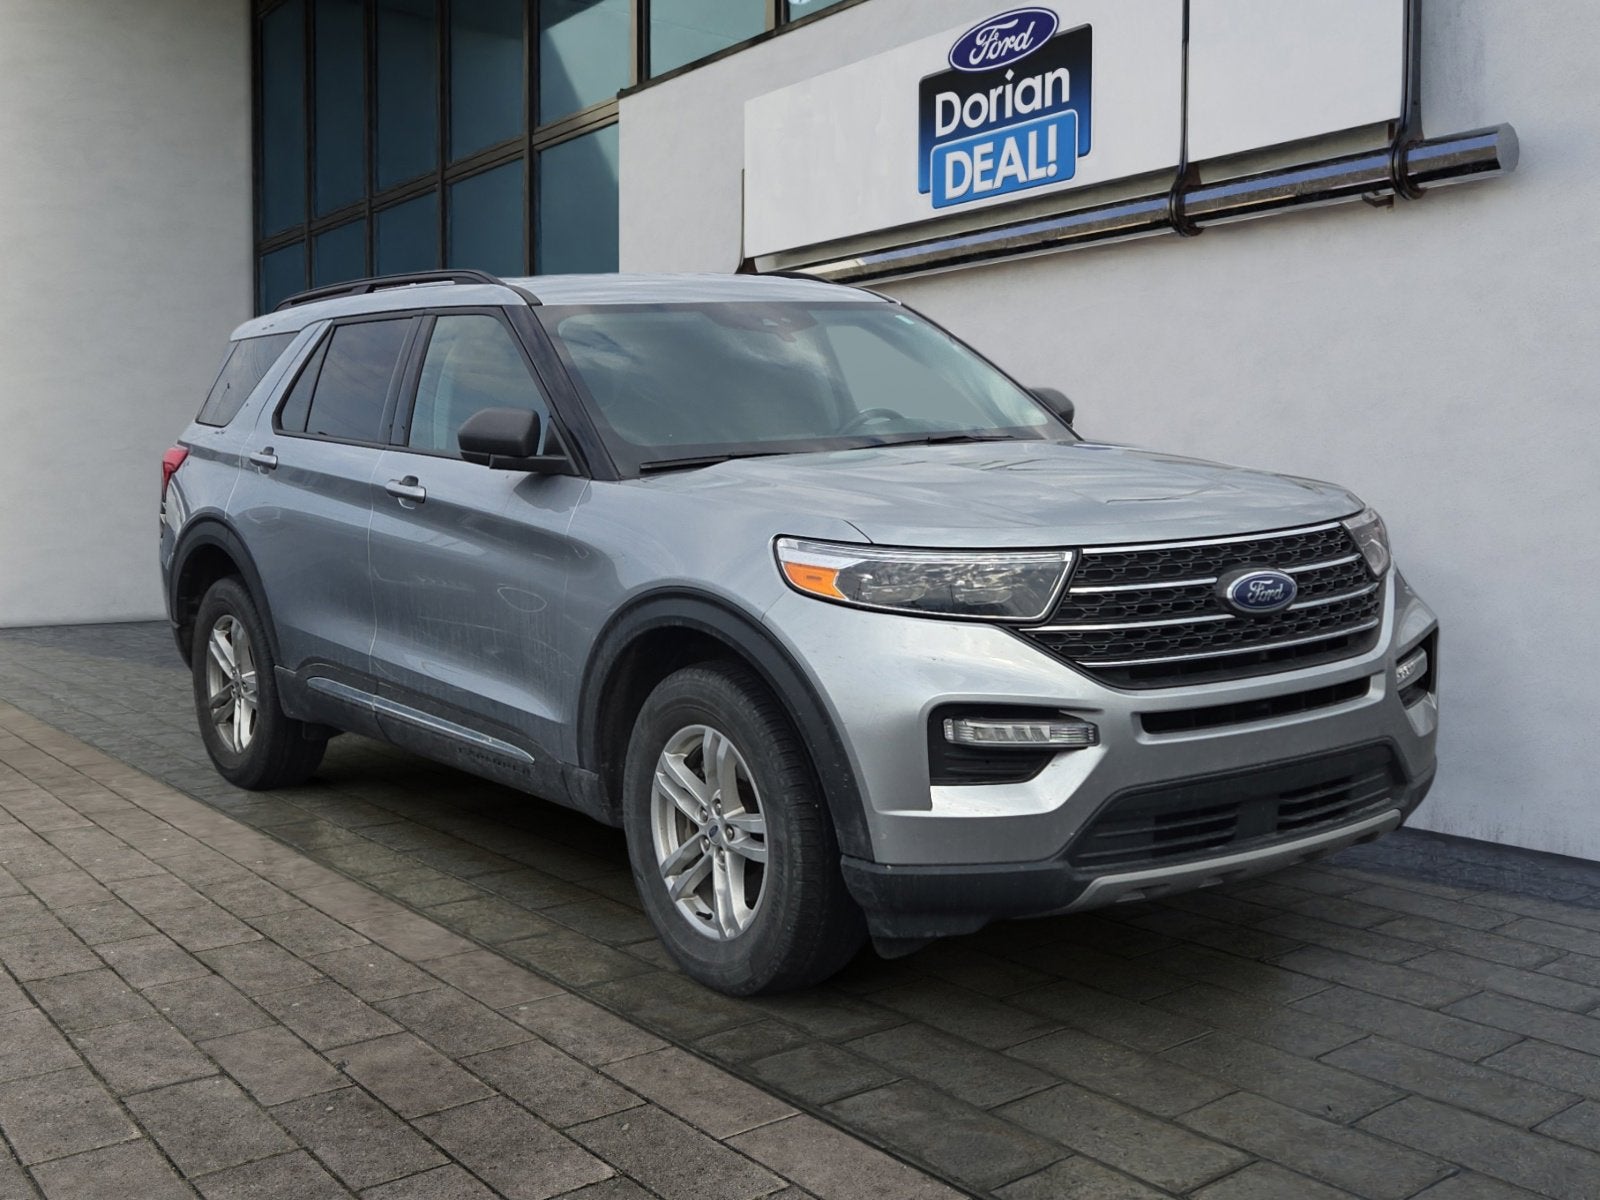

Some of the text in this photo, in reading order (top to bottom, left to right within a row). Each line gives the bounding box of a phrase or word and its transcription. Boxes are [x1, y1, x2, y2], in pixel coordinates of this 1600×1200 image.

[969, 18, 1036, 65] Ford
[935, 67, 1070, 138] Dorian
[945, 124, 1058, 200] DEAL!
[1247, 579, 1284, 603] Ford
